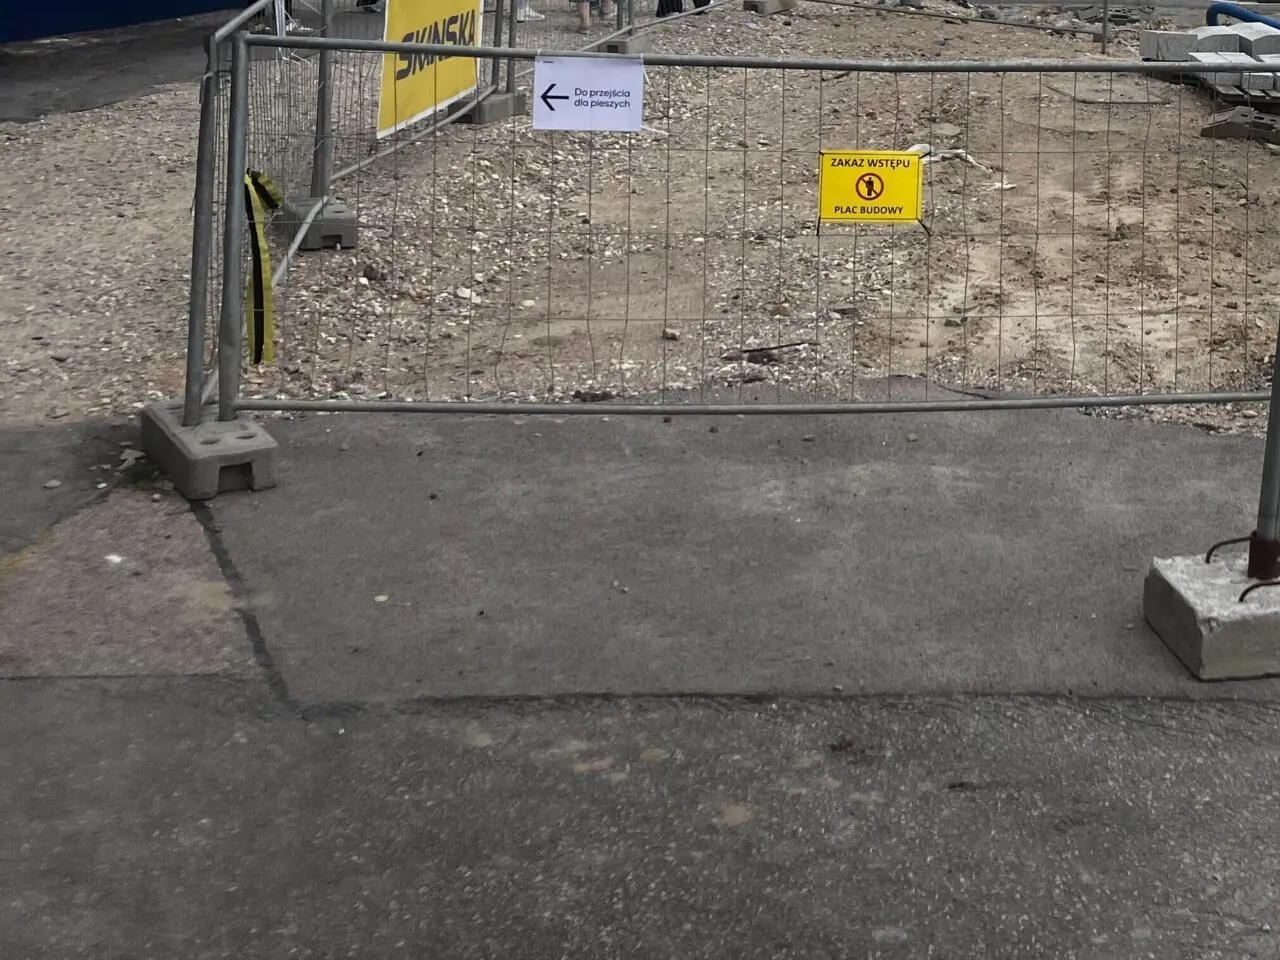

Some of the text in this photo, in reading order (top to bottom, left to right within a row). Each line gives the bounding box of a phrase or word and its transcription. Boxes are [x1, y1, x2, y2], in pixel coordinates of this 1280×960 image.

[574, 87, 631, 99] Do przejścia
[574, 99, 631, 109] dla pieszych
[831, 158, 910, 170] ZAKAZ WSTĘPU
[834, 206, 904, 214] PLAC BUDOWY
